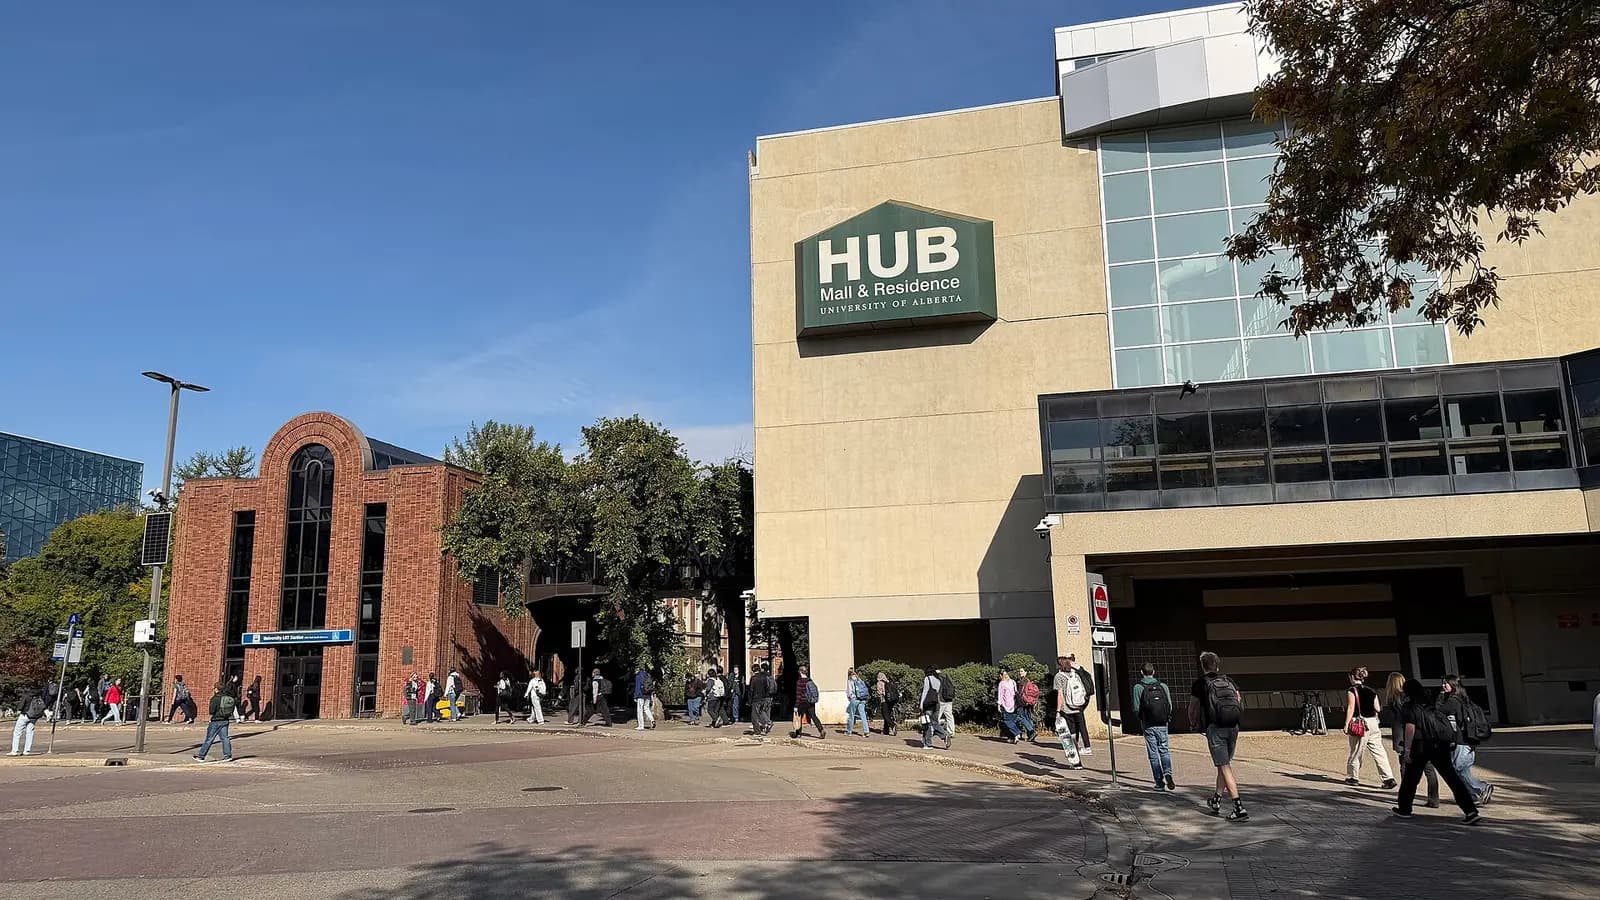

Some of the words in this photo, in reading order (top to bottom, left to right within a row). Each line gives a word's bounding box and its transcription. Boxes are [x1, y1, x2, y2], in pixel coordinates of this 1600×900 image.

[818, 226, 960, 284] HUB
[820, 284, 852, 301] Mall
[858, 284, 869, 298] &
[874, 276, 960, 296] Residence
[820, 301, 887, 315] UNIVERSITY
[892, 300, 907, 308] OF
[912, 295, 962, 306] ALBERTA
